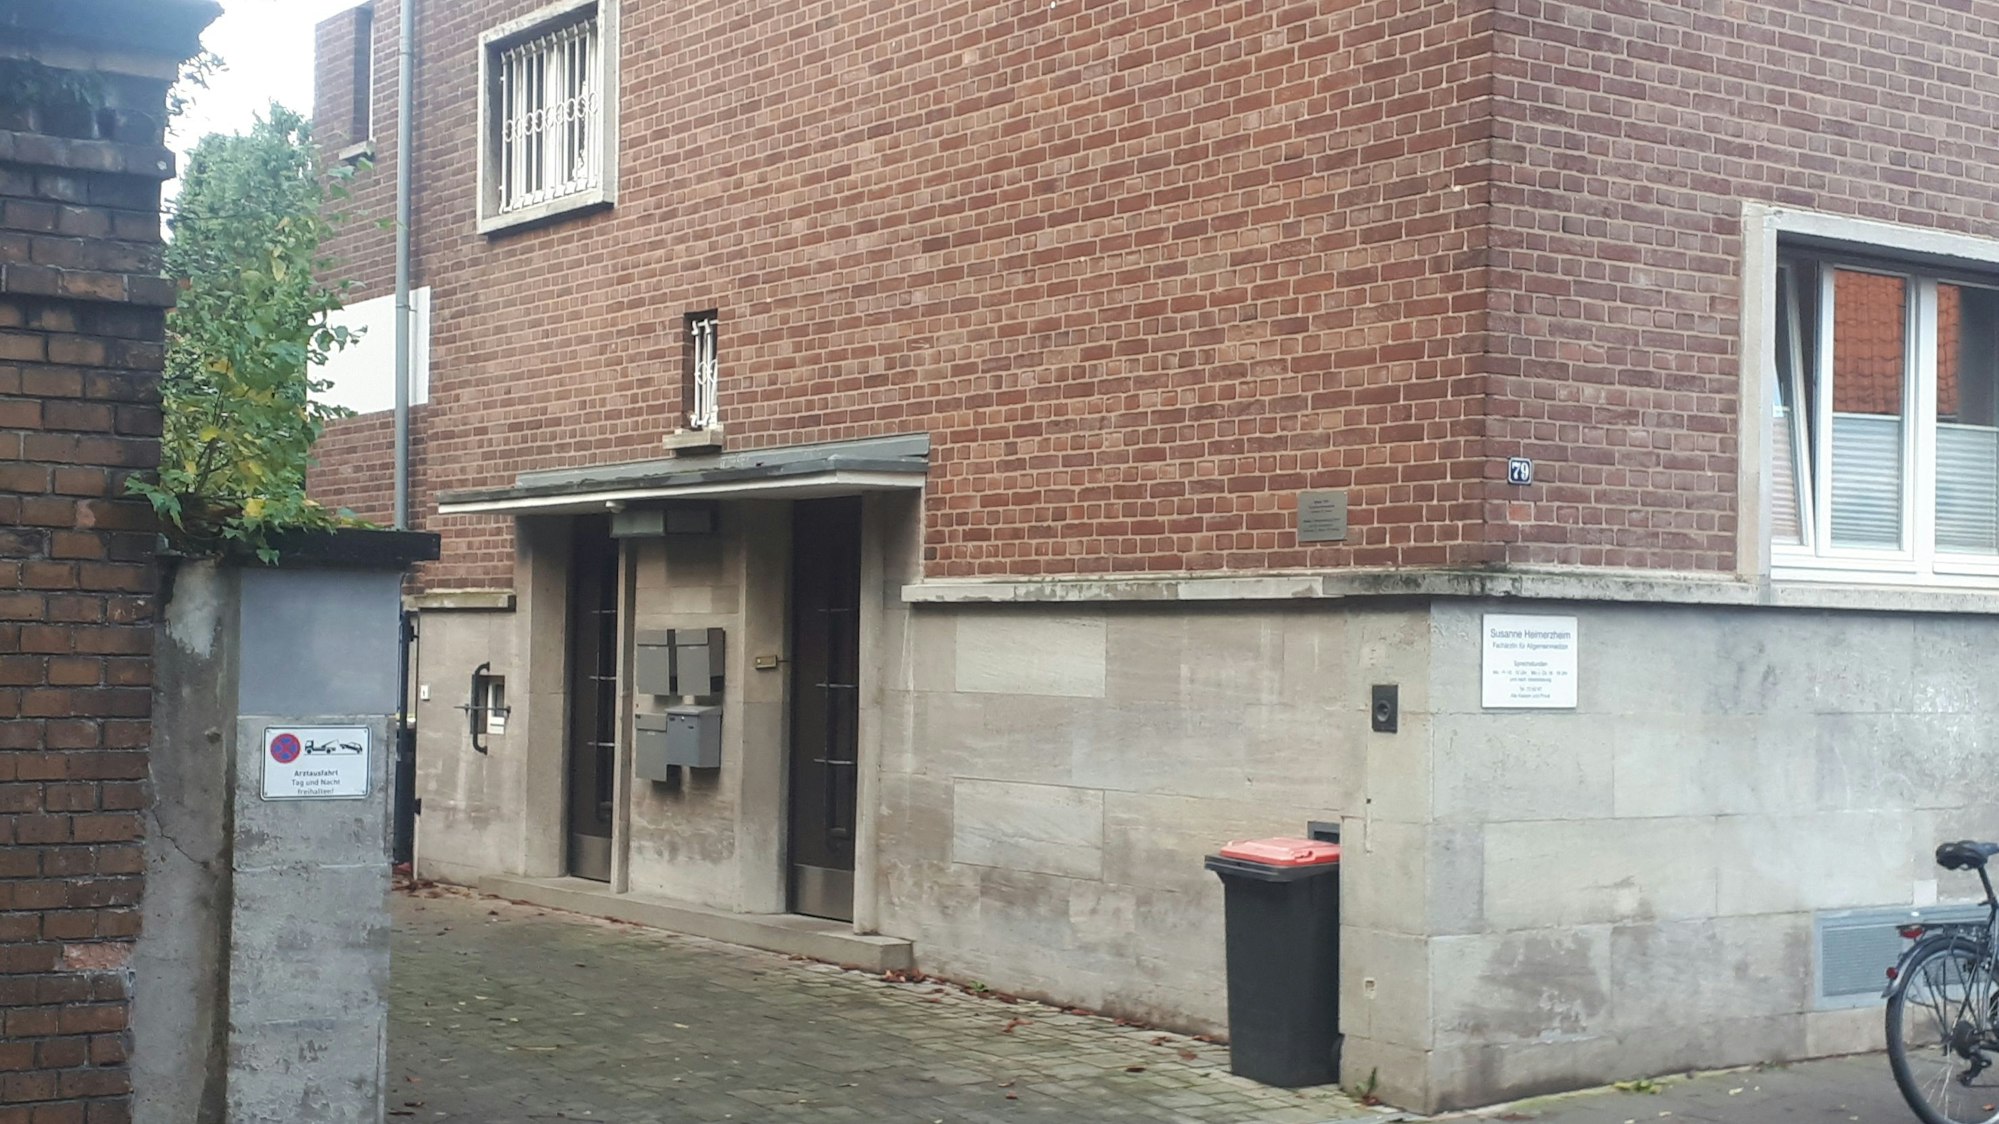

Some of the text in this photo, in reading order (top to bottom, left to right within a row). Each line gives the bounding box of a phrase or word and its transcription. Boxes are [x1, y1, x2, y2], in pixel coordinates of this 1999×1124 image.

[1511, 461, 1529, 481] 79
[1490, 628, 1571, 640] Susanne Heimerzheim
[294, 769, 339, 777] Arztausfahrt
[291, 779, 304, 787] Tag
